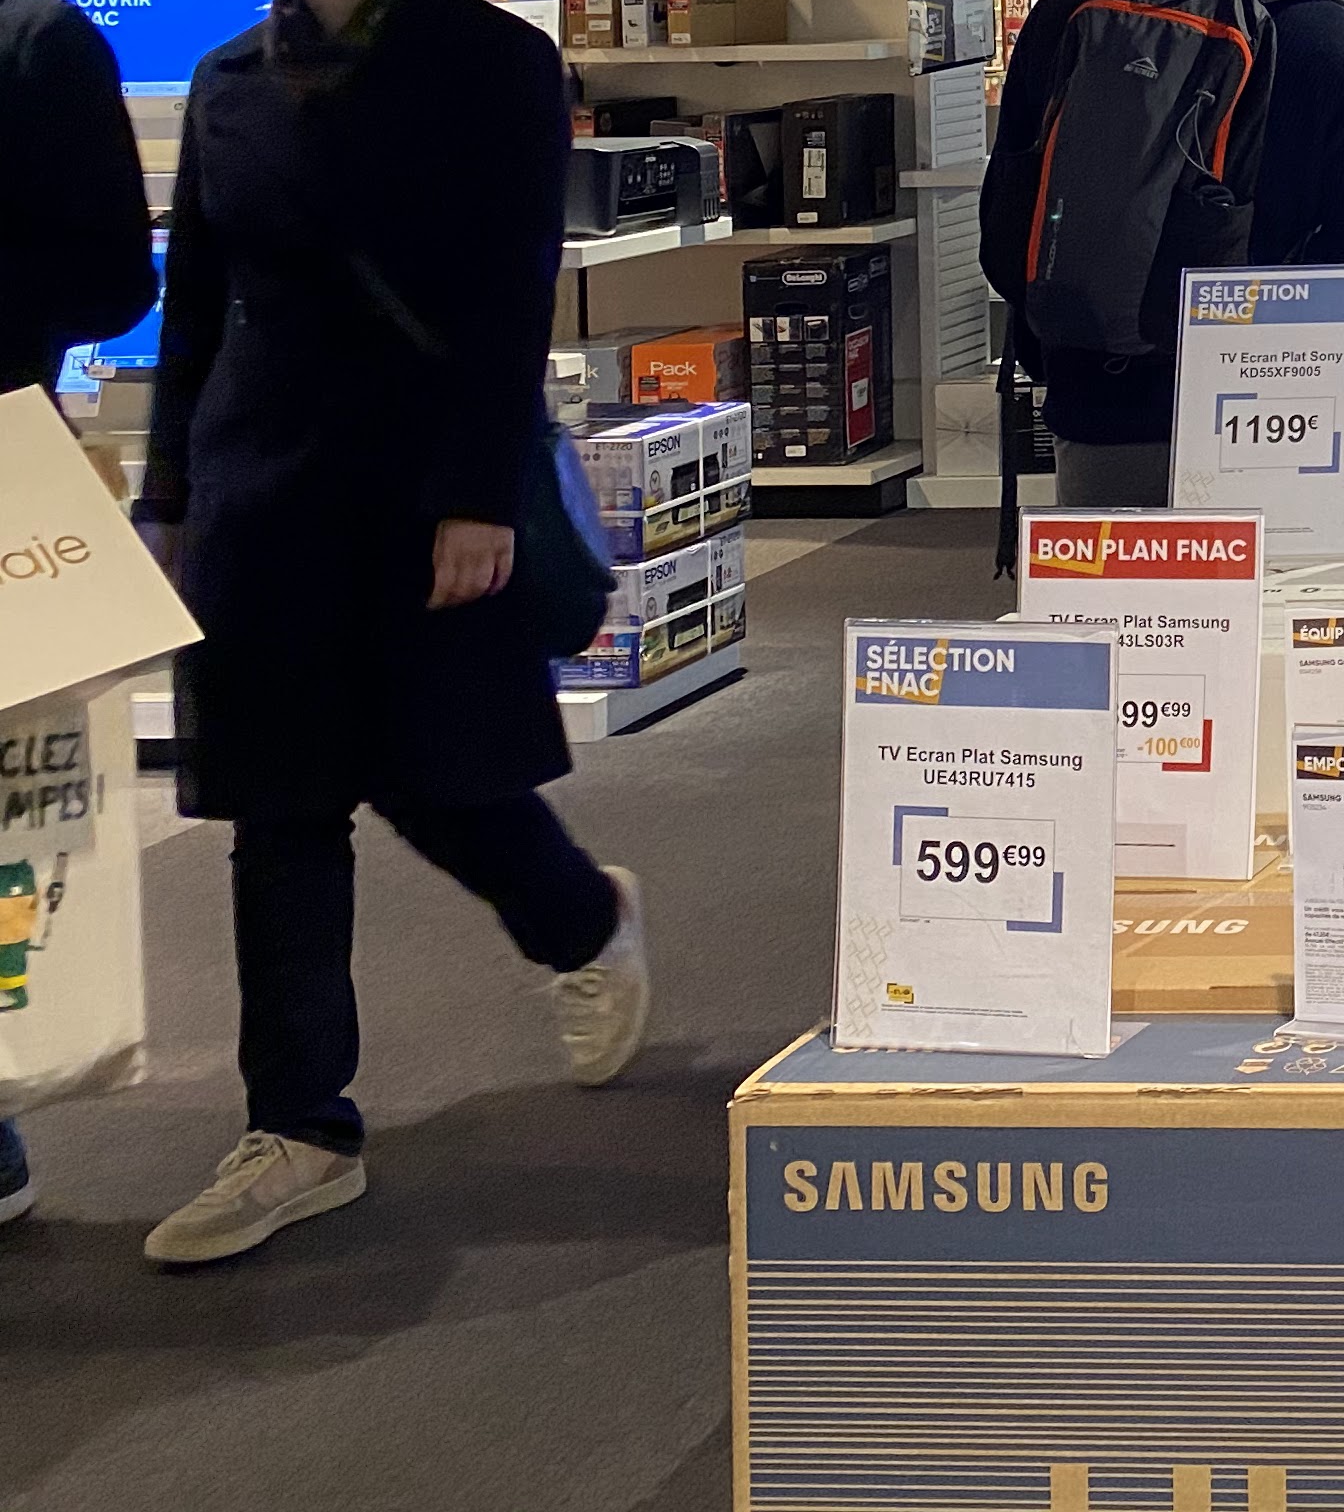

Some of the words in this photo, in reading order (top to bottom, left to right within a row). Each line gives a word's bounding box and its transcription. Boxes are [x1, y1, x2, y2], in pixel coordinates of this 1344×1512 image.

[1005, 8, 1029, 18] FNA
[1198, 281, 1310, 303] SÉLECTION
[1197, 302, 1255, 321] FNAC
[649, 361, 697, 376] Pack
[1219, 352, 1237, 364] TV
[1240, 352, 1277, 364] Ecran
[1281, 351, 1306, 364] Plat
[1310, 350, 1343, 366] Sony
[1239, 364, 1322, 380] KD55XF9005
[1224, 413, 1319, 446] 1199€
[648, 434, 681, 458] EPSON
[0, 535, 91, 585] aje
[1037, 538, 1094, 562] BON
[1100, 538, 1169, 562] PLAN
[1176, 538, 1248, 563] FNAC
[644, 560, 677, 585] EPSON
[1123, 614, 1153, 630] Plat
[1157, 614, 1231, 634] Samsung
[1118, 632, 1185, 649] 43LS03R
[865, 639, 1016, 674] SÉLECTION
[1299, 658, 1336, 667] SAMSUNG
[864, 670, 941, 698] FNAC
[0, 730, 83, 778] CLEZ
[878, 745, 901, 762] TV
[906, 745, 956, 764] Ecran
[960, 746, 996, 765] Plat
[1000, 748, 1084, 772] Samsung
[923, 768, 1036, 789] UE43RU7415
[1302, 793, 1342, 802] SAMSUNG
[1112, 918, 1250, 935] SUNG
[782, 1160, 1110, 1213] SAMSUNG
